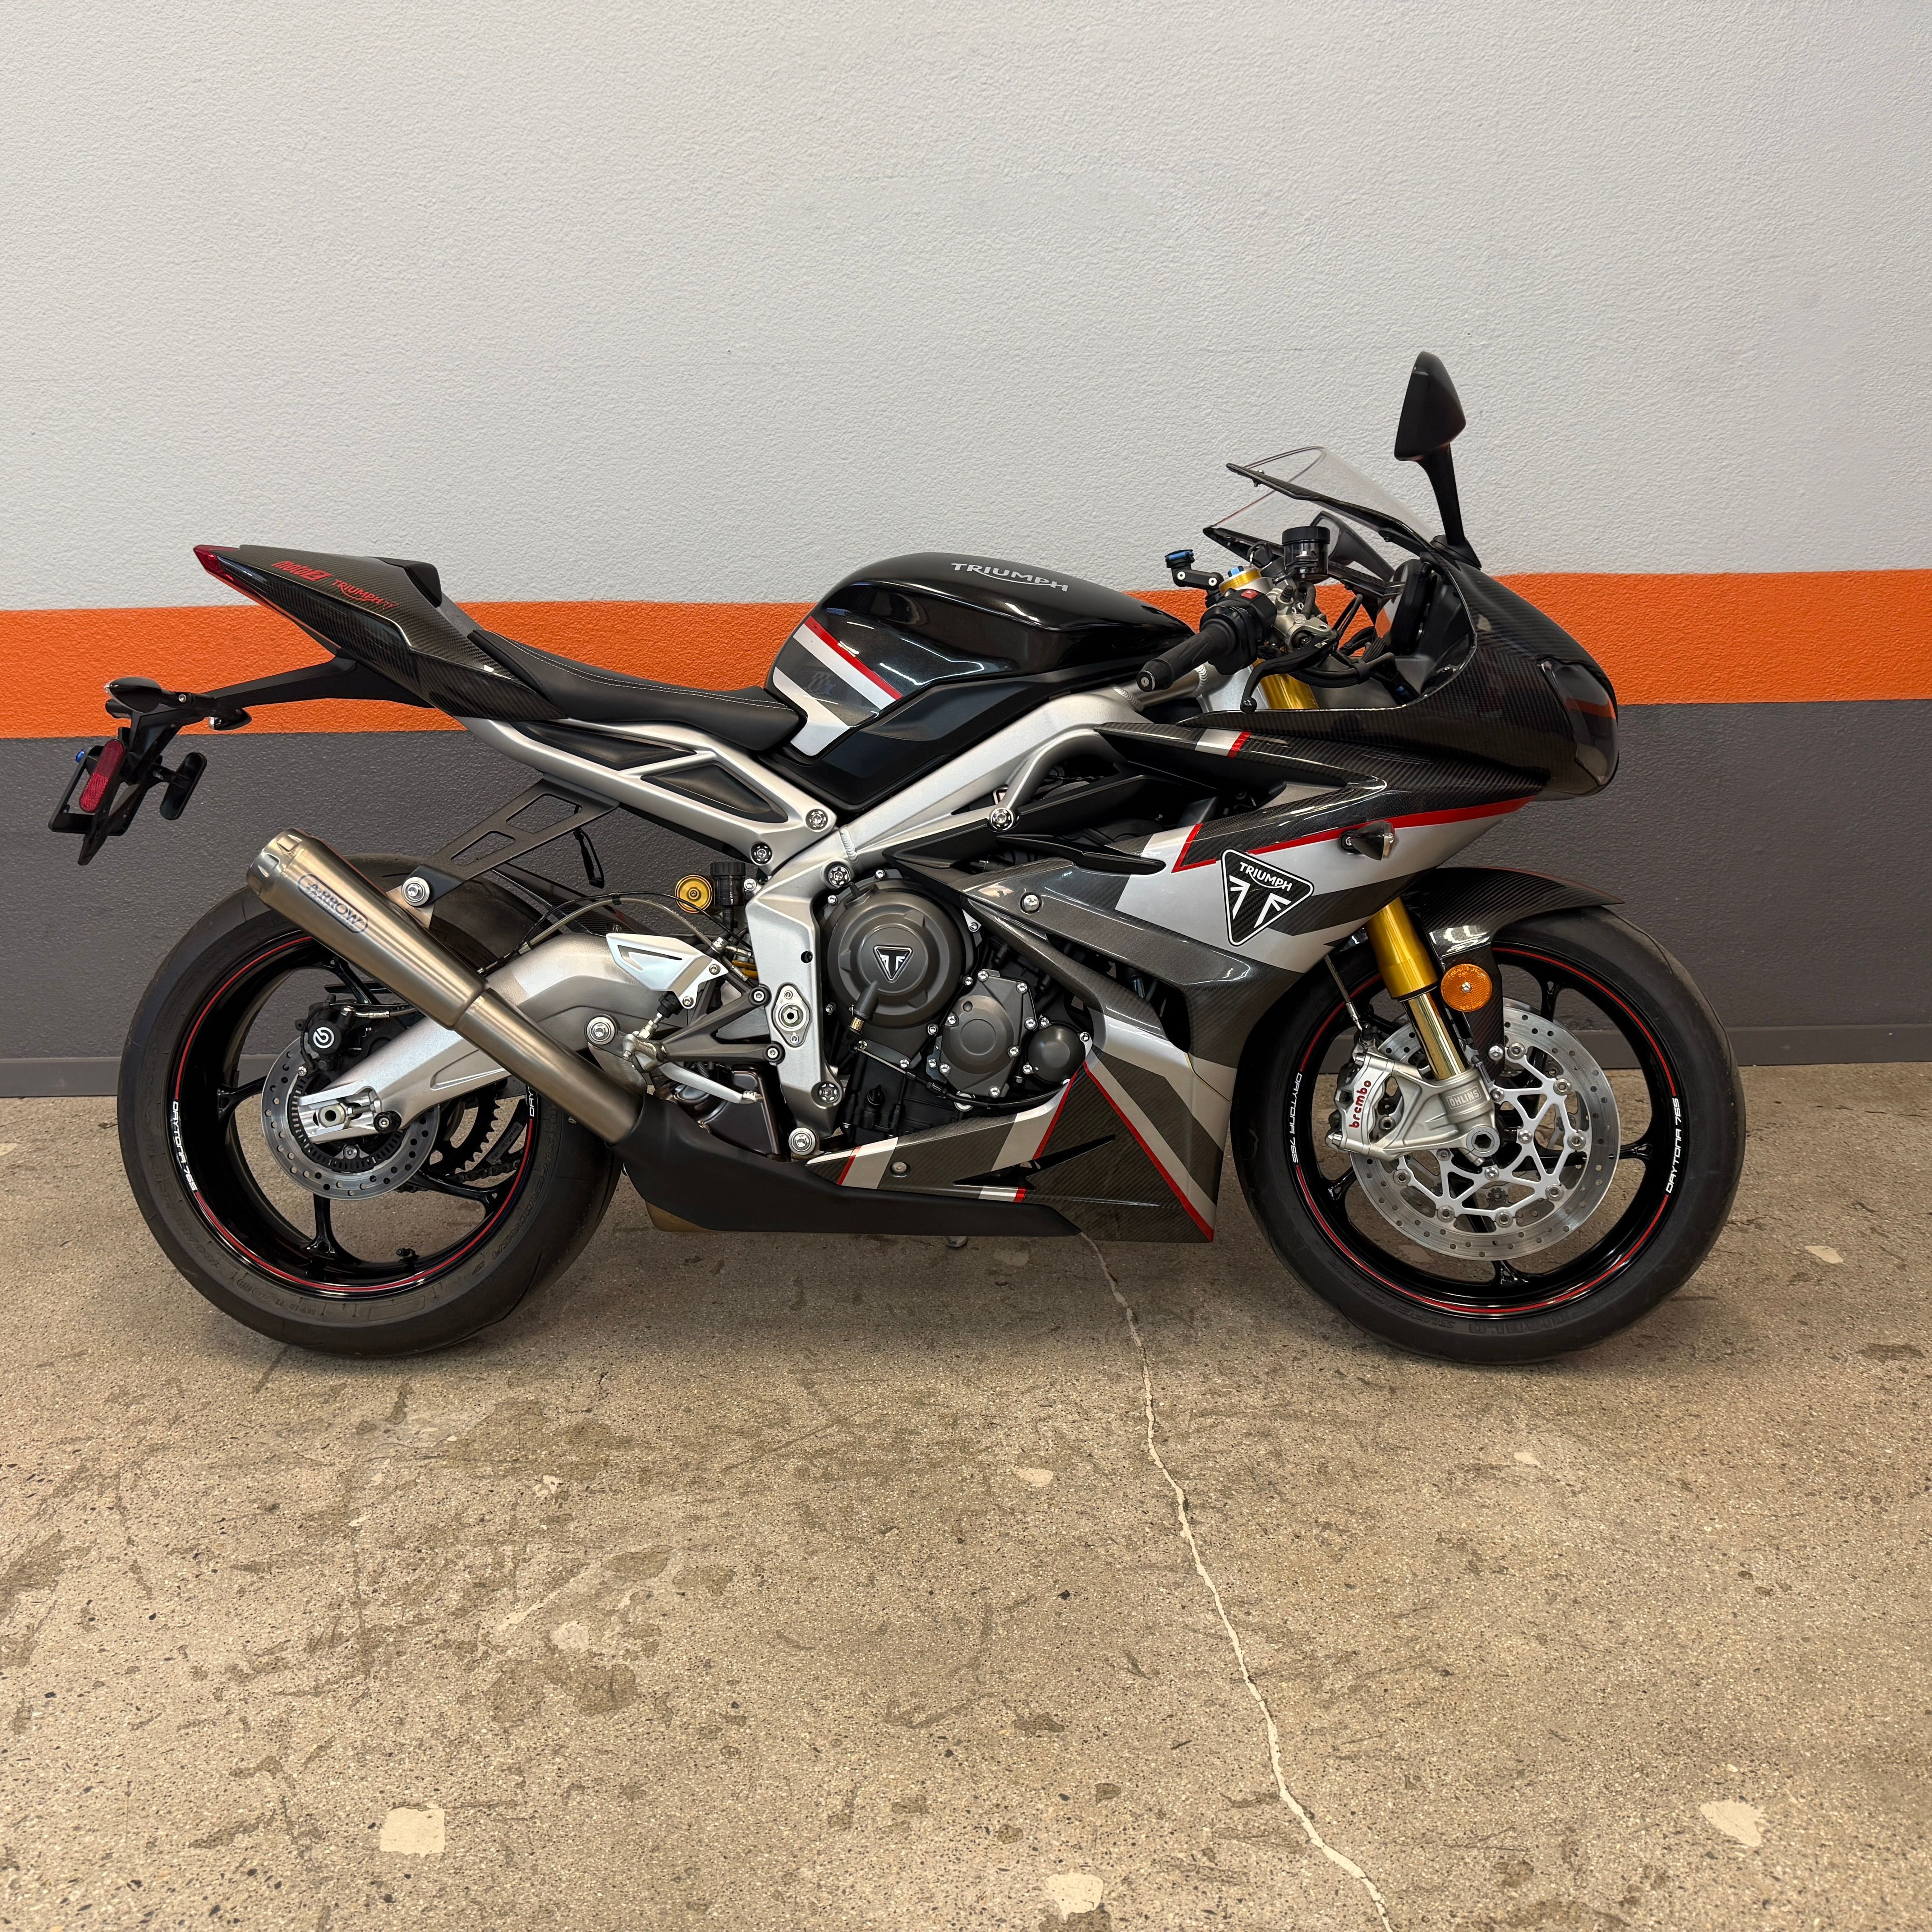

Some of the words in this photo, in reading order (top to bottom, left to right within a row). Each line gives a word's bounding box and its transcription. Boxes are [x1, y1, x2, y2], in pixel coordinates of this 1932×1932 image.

[332, 579, 384, 604] TRIUMPH
[951, 563, 1068, 592] TRIUMPH
[1240, 862, 1293, 892] TRIUMPH
[306, 882, 363, 925] ARROW
[1290, 1072, 1302, 1134] DAYTONA
[1348, 1080, 1371, 1128] brembo
[1448, 1089, 1480, 1107] ÖHLINS
[1672, 1098, 1682, 1125] 765
[172, 1101, 186, 1163] DAYTONA
[184, 1165, 198, 1191] 765
[1290, 1137, 1299, 1163] 765
[1665, 1128, 1682, 1194] DAYTONA
